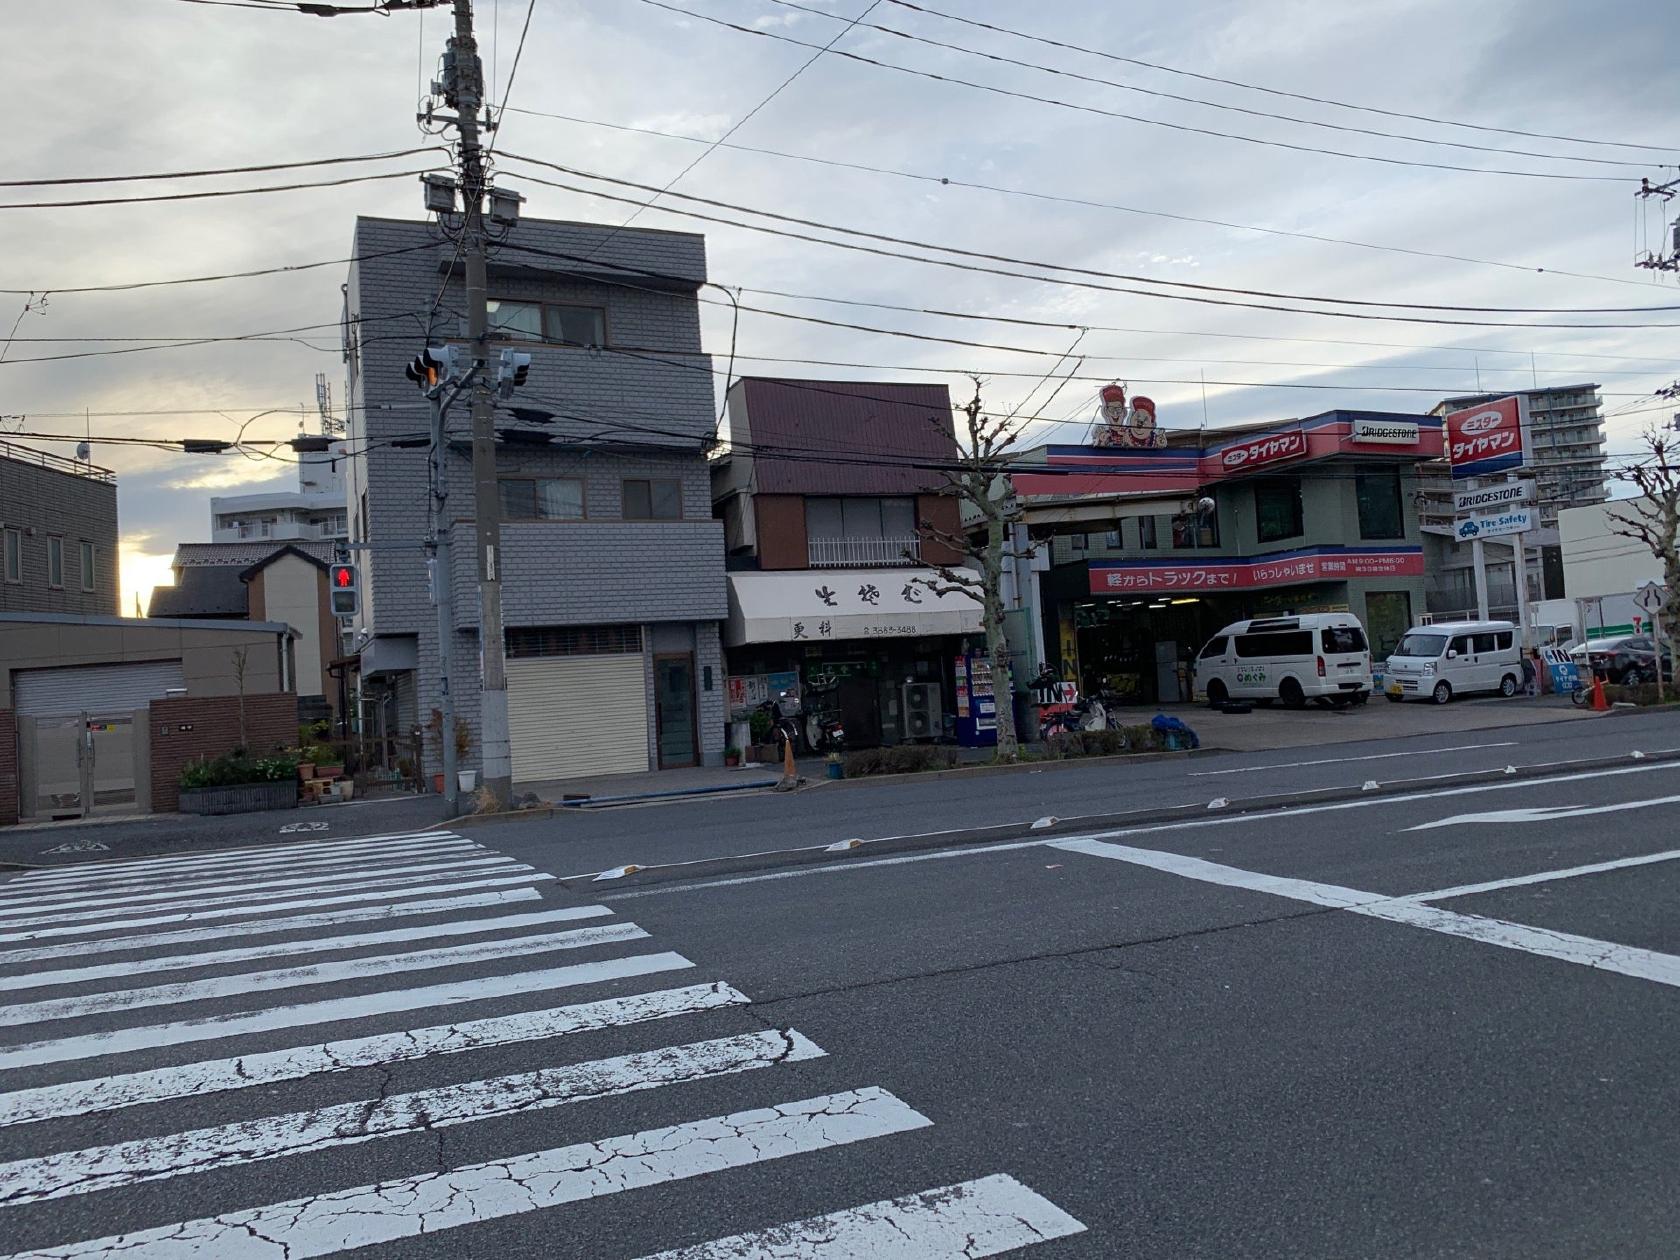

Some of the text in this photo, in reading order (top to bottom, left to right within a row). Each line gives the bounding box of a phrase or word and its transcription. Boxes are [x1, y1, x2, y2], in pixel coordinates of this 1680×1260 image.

[1466, 416, 1499, 429] ミスター
[1361, 425, 1417, 438] BRIDGESTONE
[1249, 436, 1300, 460] タイヤマン
[1453, 432, 1514, 459] タイヤマン
[1459, 486, 1522, 507] BRIDGESTONE
[1480, 514, 1526, 529] Tire Safety
[1253, 563, 1315, 580] いらっしゃいませ
[793, 621, 832, 639] 更科
[1551, 648, 1570, 663] IN
